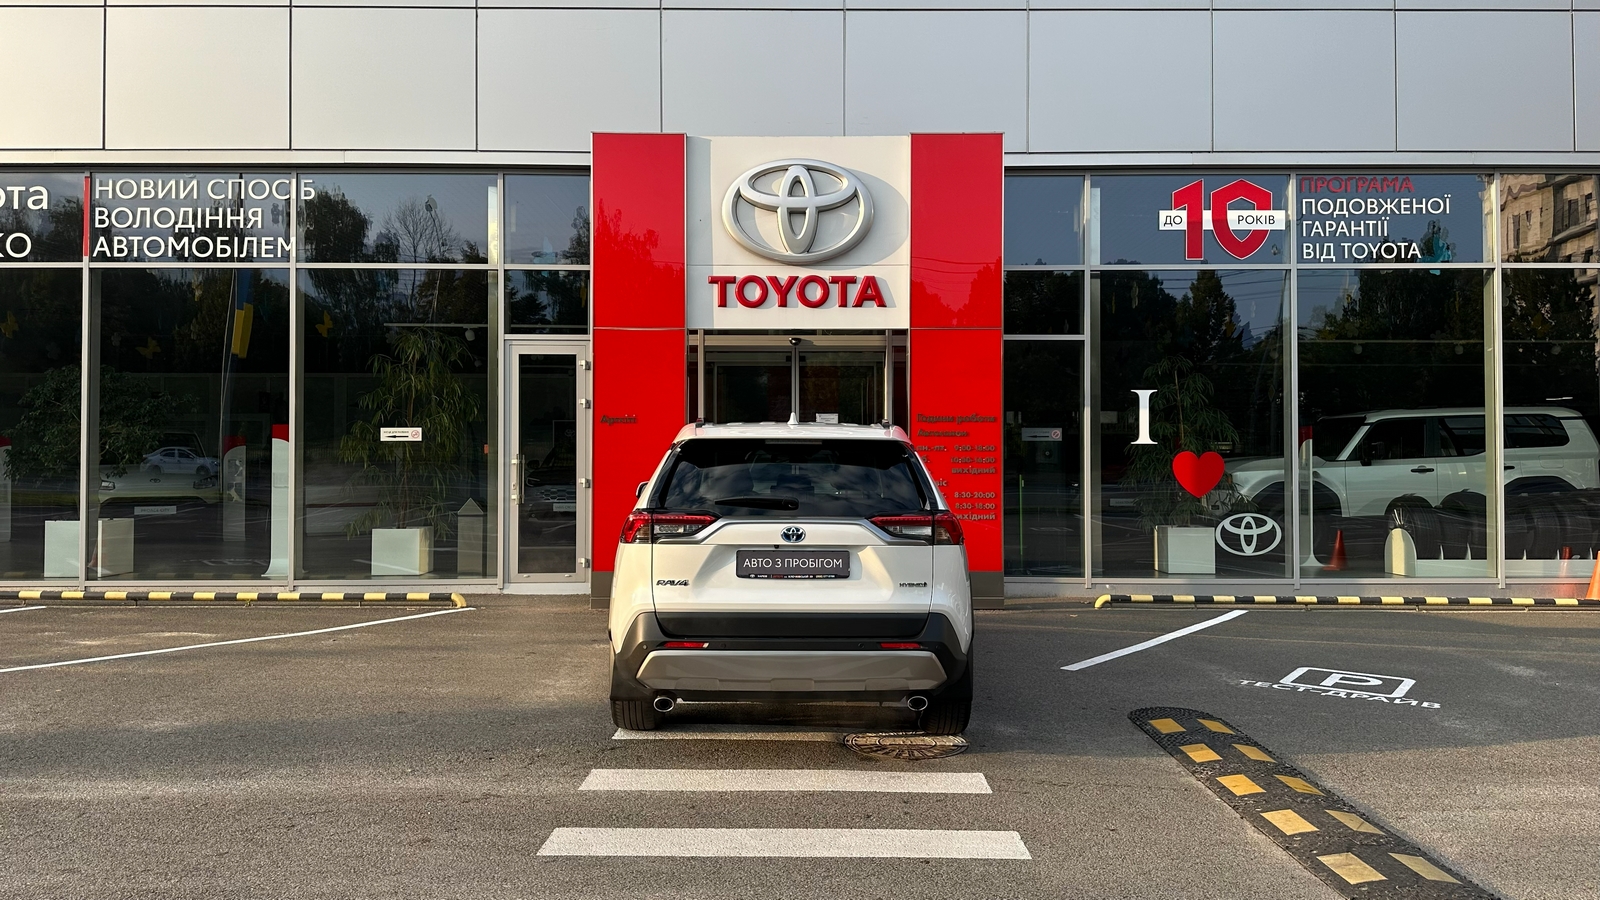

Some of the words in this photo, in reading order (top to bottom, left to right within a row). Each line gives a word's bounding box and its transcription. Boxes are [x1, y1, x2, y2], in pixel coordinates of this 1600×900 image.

[95, 173, 198, 200] НОВИЙ
[206, 178, 316, 200] СПОСІБ
[1301, 176, 1415, 194] ПРОГРАМА
[0, 185, 48, 210] та
[1302, 194, 1452, 217] ПОДОВЖЕНОЇ
[94, 207, 263, 233] ВОЛОДІННЯ
[1163, 214, 1183, 227] ДО
[1172, 178, 1274, 260] 10
[1237, 214, 1276, 226] РОКІВ
[1302, 217, 1389, 238] ГАРАНТІЇ
[92, 236, 297, 259] АВТОМОБІЛЕМ
[1302, 243, 1336, 263] ВІД
[1344, 242, 1423, 260] TOYOTA
[708, 274, 887, 308] TOYOTA
[1130, 389, 1158, 444] I
[951, 465, 996, 475] вихідний
[954, 491, 996, 499] 8:30-20:00
[955, 502, 996, 511] 8:30-18:00
[956, 511, 996, 521] ихідний
[742, 558, 773, 568] АВТО
[774, 558, 782, 568] З
[784, 558, 843, 568] ПРОБІГОМ
[656, 579, 690, 587] RAV4
[1239, 678, 1442, 709] ТЕСТ-ДРАЙВ
